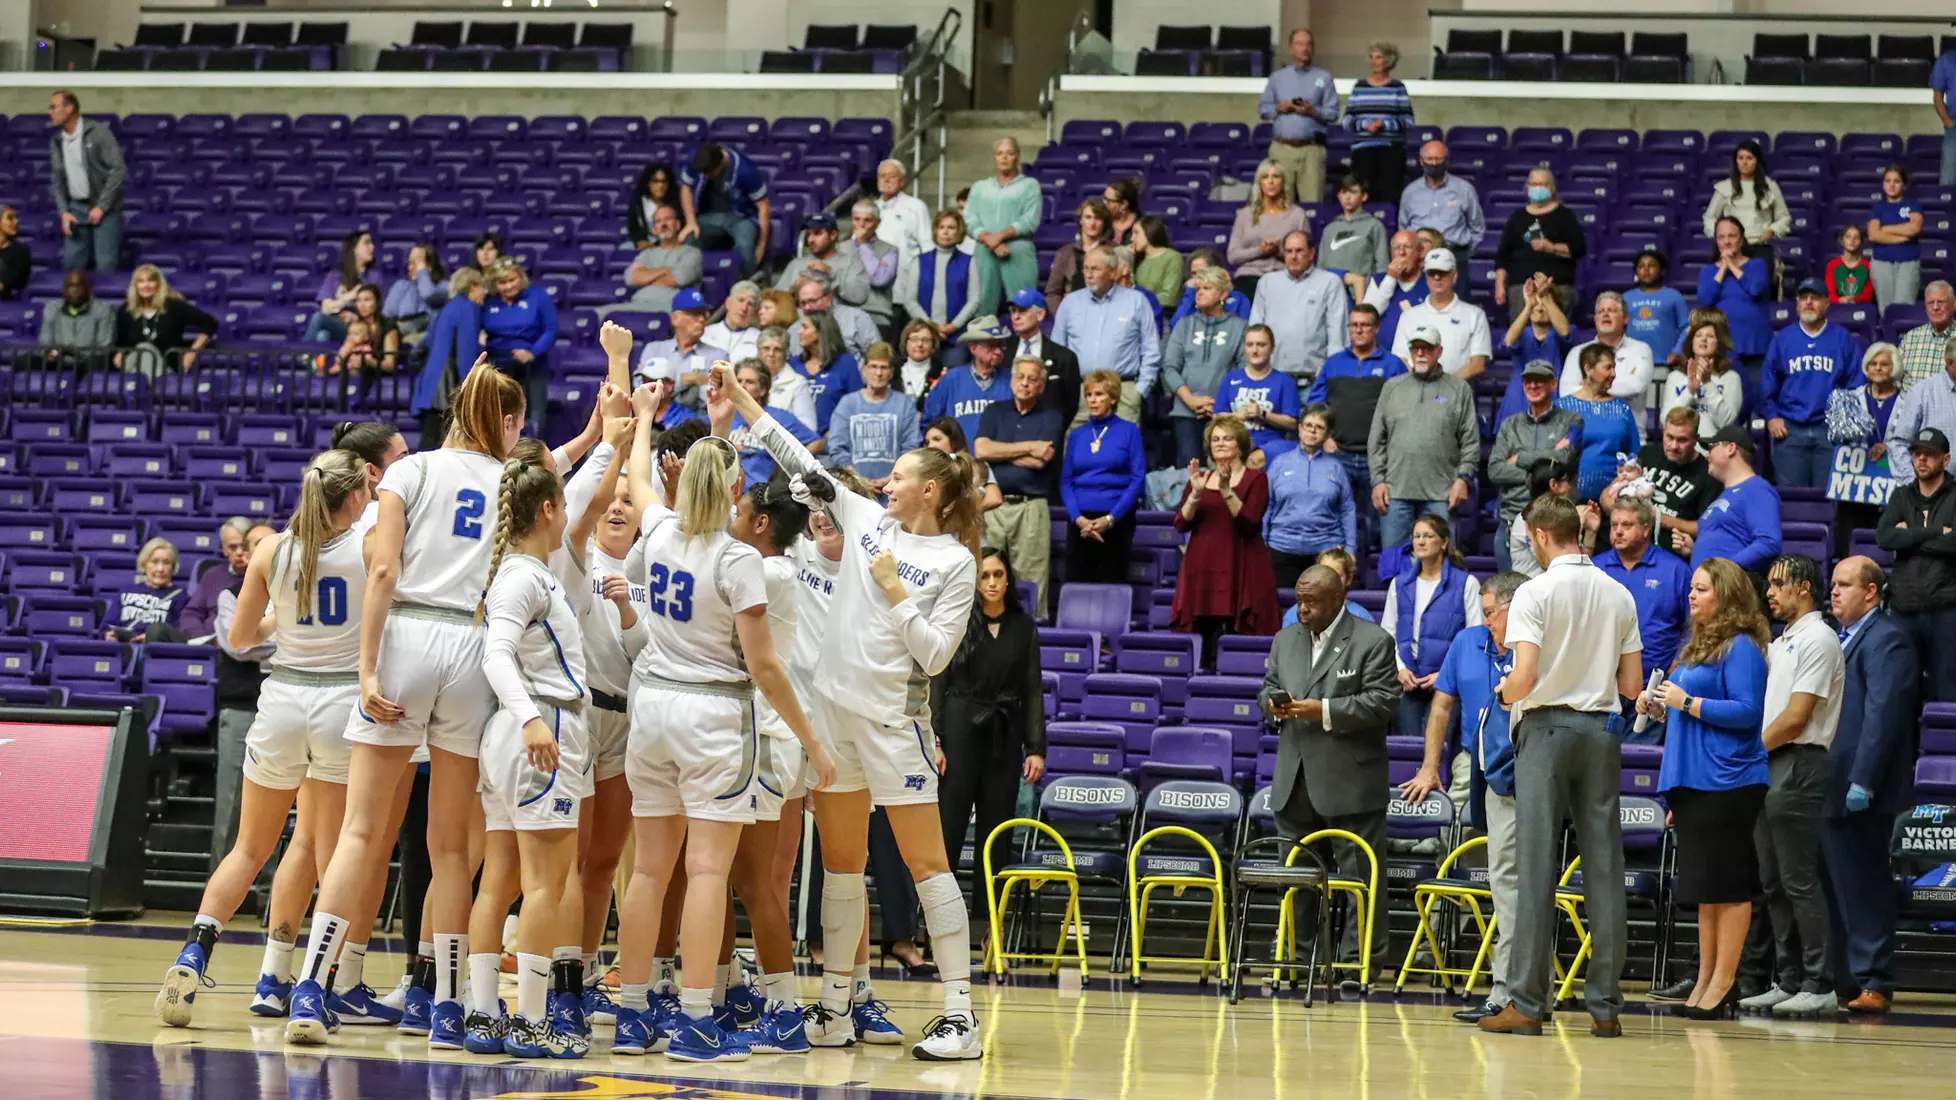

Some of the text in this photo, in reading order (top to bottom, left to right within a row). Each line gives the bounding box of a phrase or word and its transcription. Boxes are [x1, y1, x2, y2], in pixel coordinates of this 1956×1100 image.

[1788, 355, 1835, 374] MTSU
[1235, 387, 1271, 401] JUST
[954, 399, 996, 418] RAID
[1643, 467, 1695, 498] MTSU
[452, 487, 486, 540] 2
[650, 562, 695, 623] 23
[1055, 786, 1125, 804] BISONS
[1159, 790, 1231, 810] BISONS
[1387, 800, 1441, 816] SONS
[1911, 804, 1950, 824] MT
[1901, 837, 1956, 850] BARNE
[1148, 858, 1200, 871] LIPSCOMB
[1387, 868, 1416, 878] COMB
[1912, 890, 1956, 901] LIPSCOM
